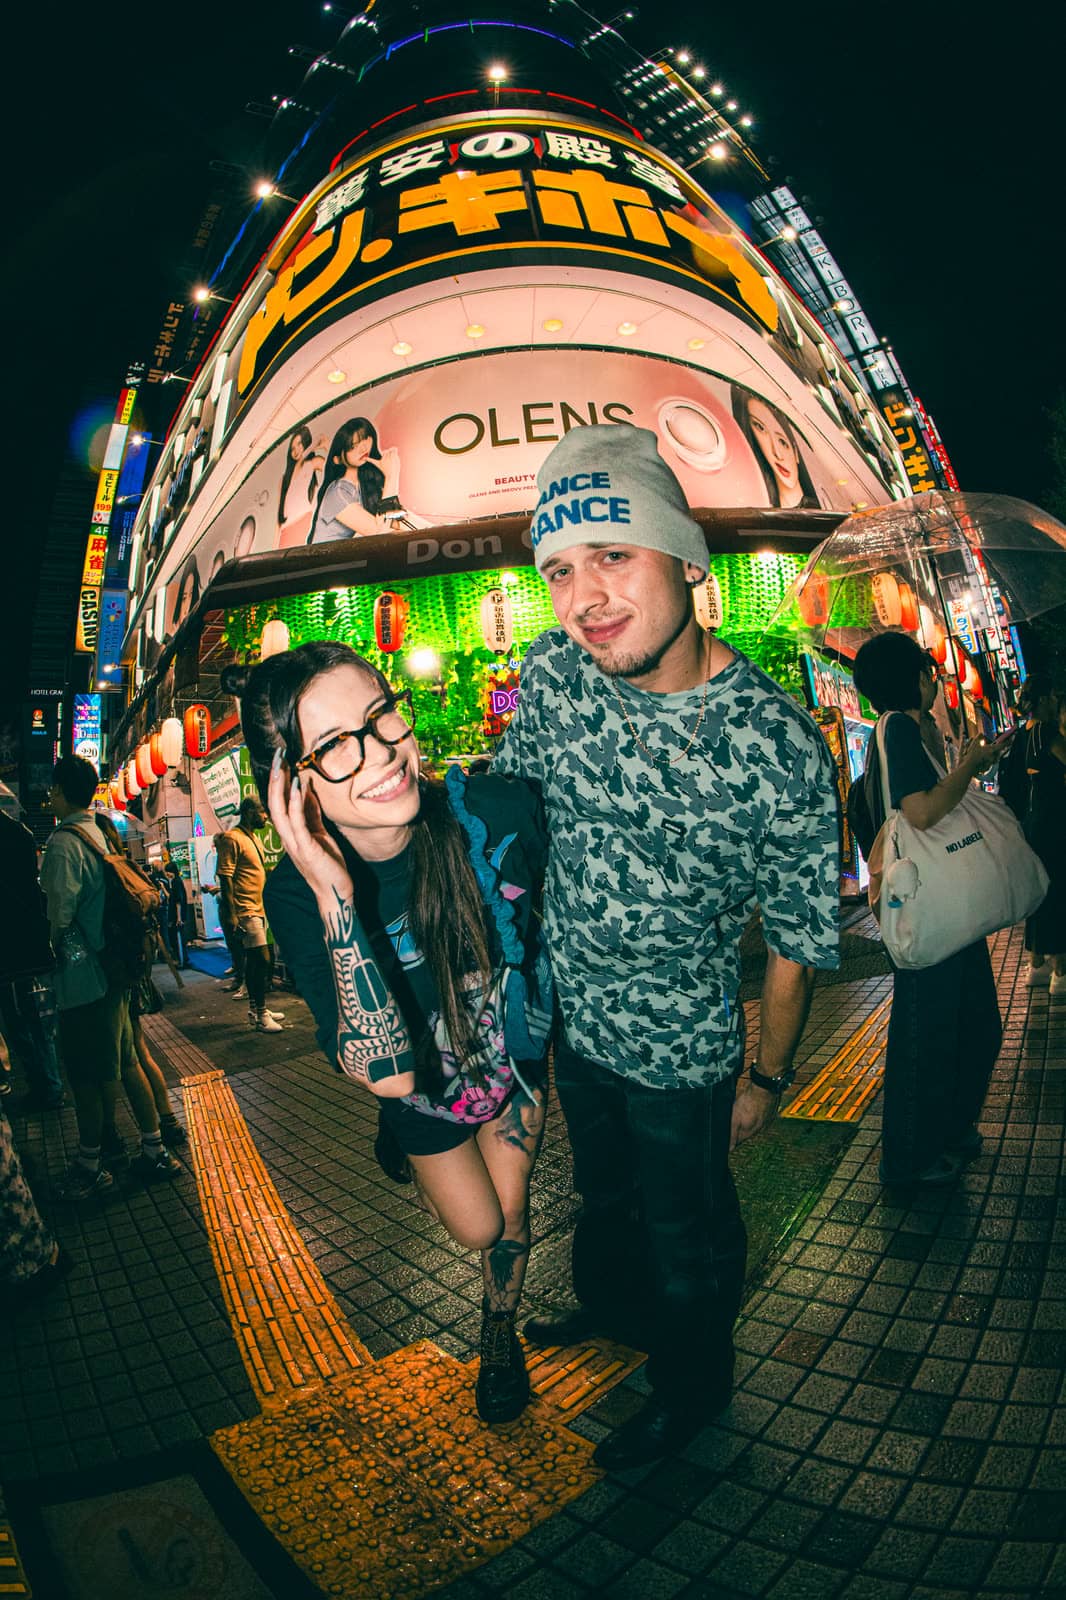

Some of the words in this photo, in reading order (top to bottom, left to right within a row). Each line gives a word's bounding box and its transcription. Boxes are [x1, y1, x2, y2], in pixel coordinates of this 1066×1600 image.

[494, 474, 536, 486] BEAUTY
[94, 526, 109, 535] 4F
[406, 534, 503, 565] Don
[81, 589, 98, 648] CASINO
[945, 842, 959, 854] NO
